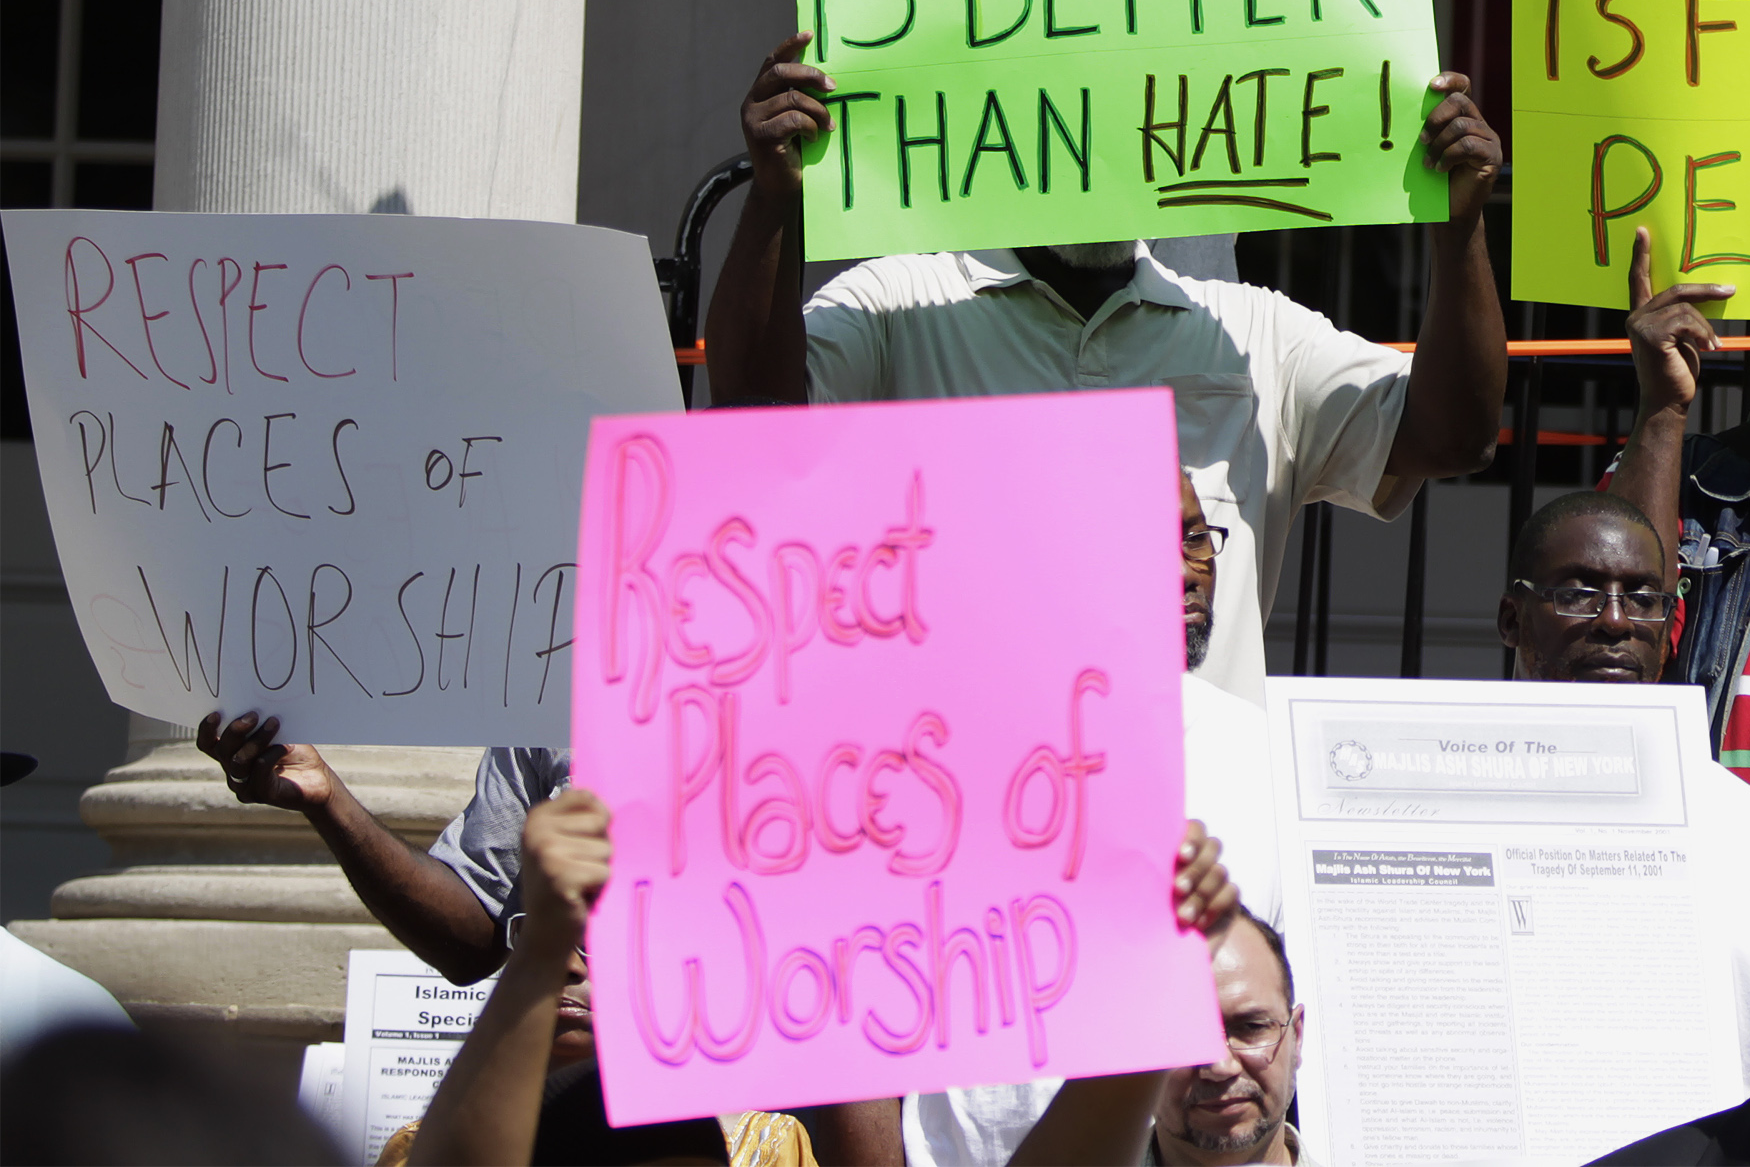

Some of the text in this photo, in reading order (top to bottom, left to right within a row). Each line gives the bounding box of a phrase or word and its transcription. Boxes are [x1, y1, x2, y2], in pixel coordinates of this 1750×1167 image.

[824, 87, 1092, 211] THAN
[64, 236, 414, 395] RESPECT
[70, 410, 359, 524] PLACES
[137, 563, 581, 707] WORSHIP
[1438, 740, 1557, 754] Voice Of The
[668, 668, 1110, 882] Places of
[1374, 752, 1635, 779] MAJLIS ASH SHURA OF NEW YORK
[1505, 848, 1686, 862] Official Position On Matters Related To The
[1316, 864, 1491, 877] Majlis Ash Shura Of New York
[1382, 877, 1425, 885] Leadership
[1531, 863, 1565, 878] Tragedy
[1567, 864, 1577, 875] Of
[1580, 864, 1625, 878] September
[1643, 865, 1662, 876] 2001
[629, 879, 1079, 1069] Worship
[415, 985, 487, 1001] Islamic
[397, 1056, 441, 1066] MAJLIS
